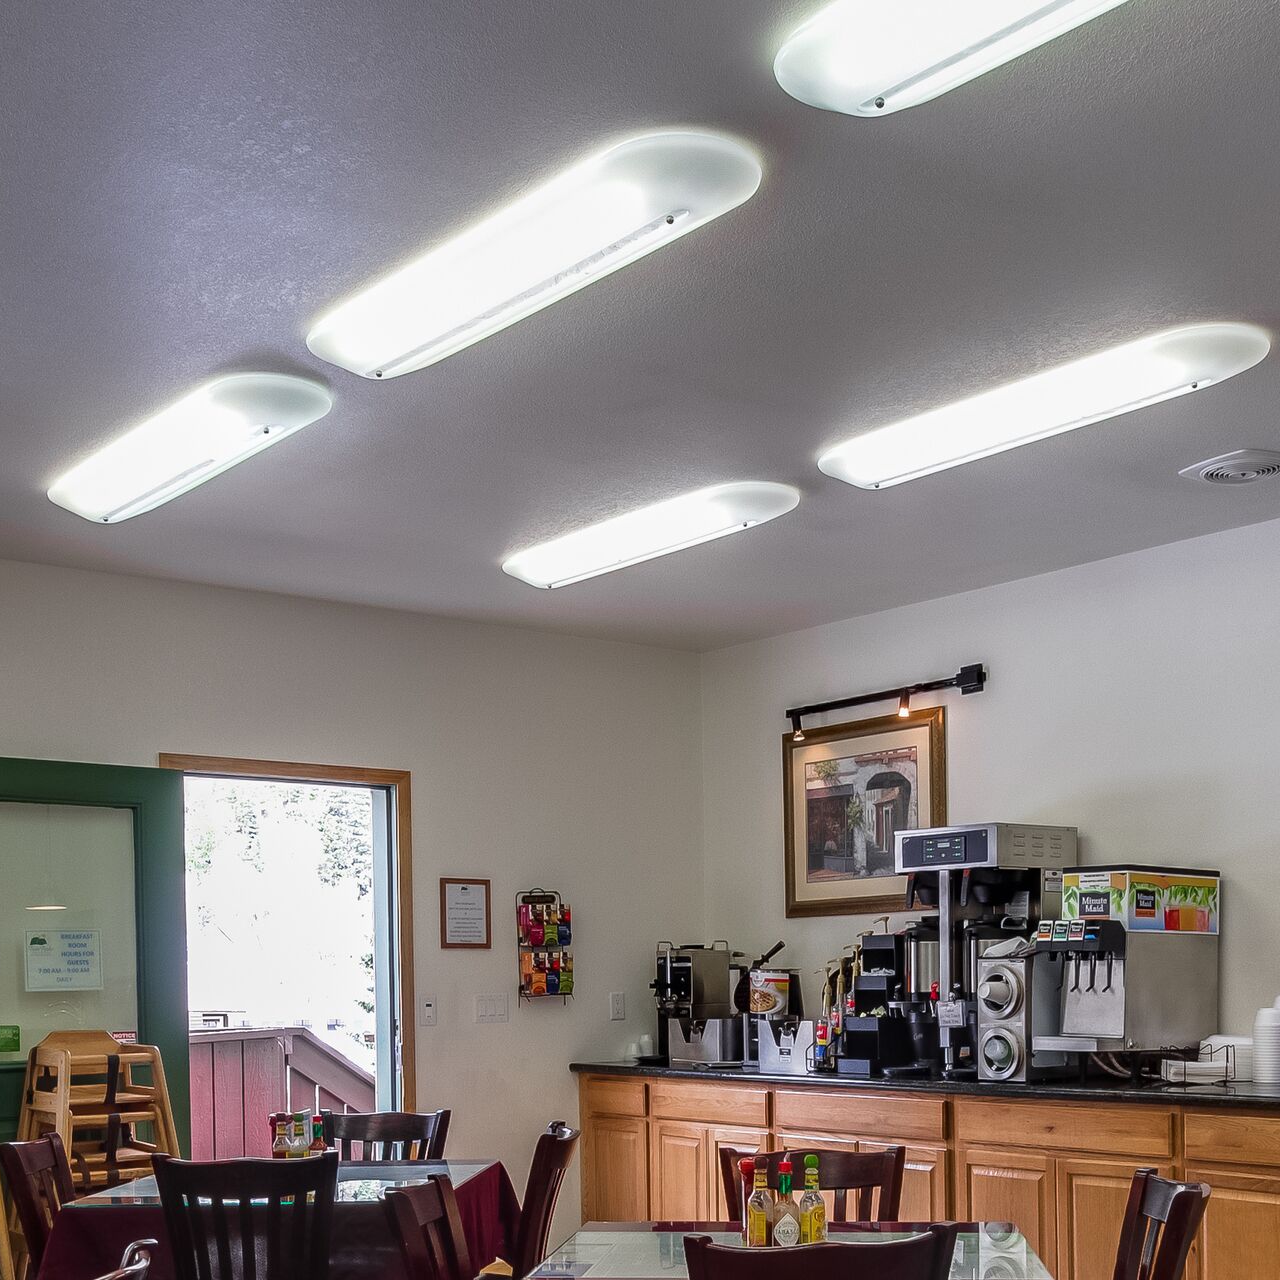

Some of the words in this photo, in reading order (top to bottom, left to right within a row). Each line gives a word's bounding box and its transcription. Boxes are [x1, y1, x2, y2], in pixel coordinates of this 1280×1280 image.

[1081, 896, 1108, 906] Minute
[1137, 892, 1154, 902] Minute
[1138, 899, 1153, 908] Maid
[1085, 905, 1104, 913] Maid
